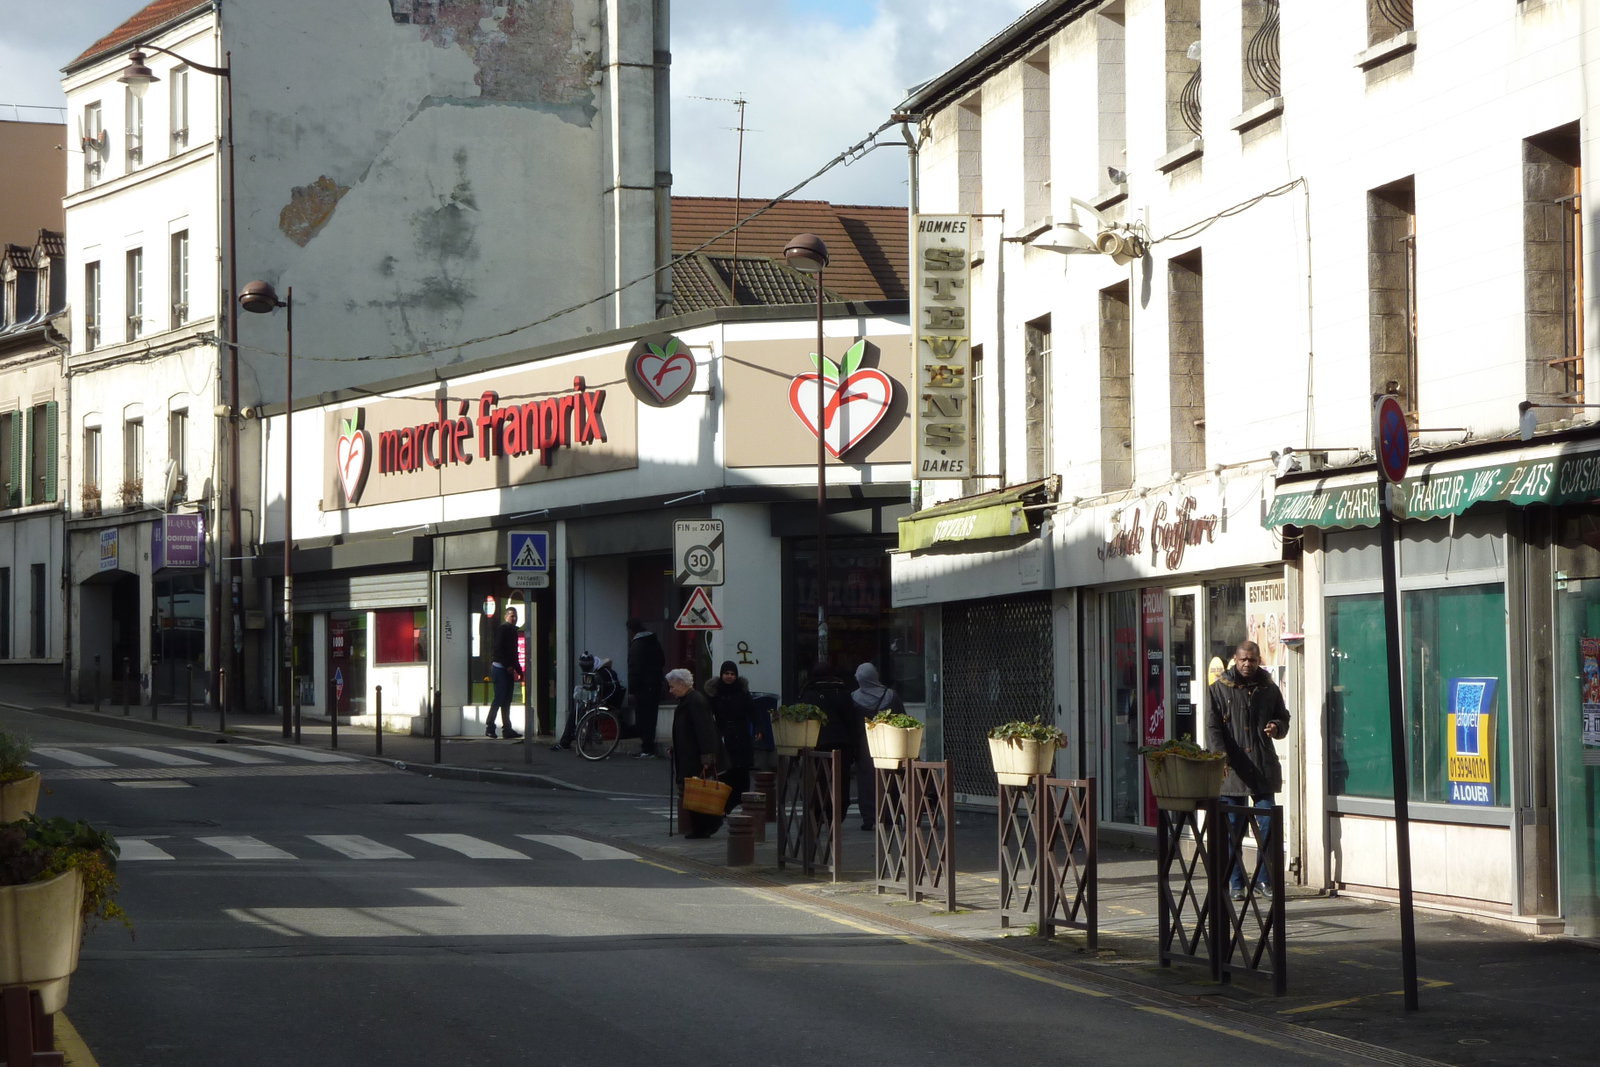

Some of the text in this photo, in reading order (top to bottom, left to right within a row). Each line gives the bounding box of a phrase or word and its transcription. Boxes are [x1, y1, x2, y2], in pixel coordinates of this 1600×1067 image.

[918, 220, 967, 234] HOMMES
[919, 247, 968, 448] STEVENS
[378, 376, 606, 476] marché franprix
[922, 459, 964, 472] DAMES
[1409, 475, 1464, 512] TRAITEUR
[1501, 462, 1554, 496] PLATS
[677, 523, 690, 532] FIN
[700, 523, 721, 531] ZONE
[690, 554, 709, 567] 30
[1460, 784, 1489, 802] LOUER
